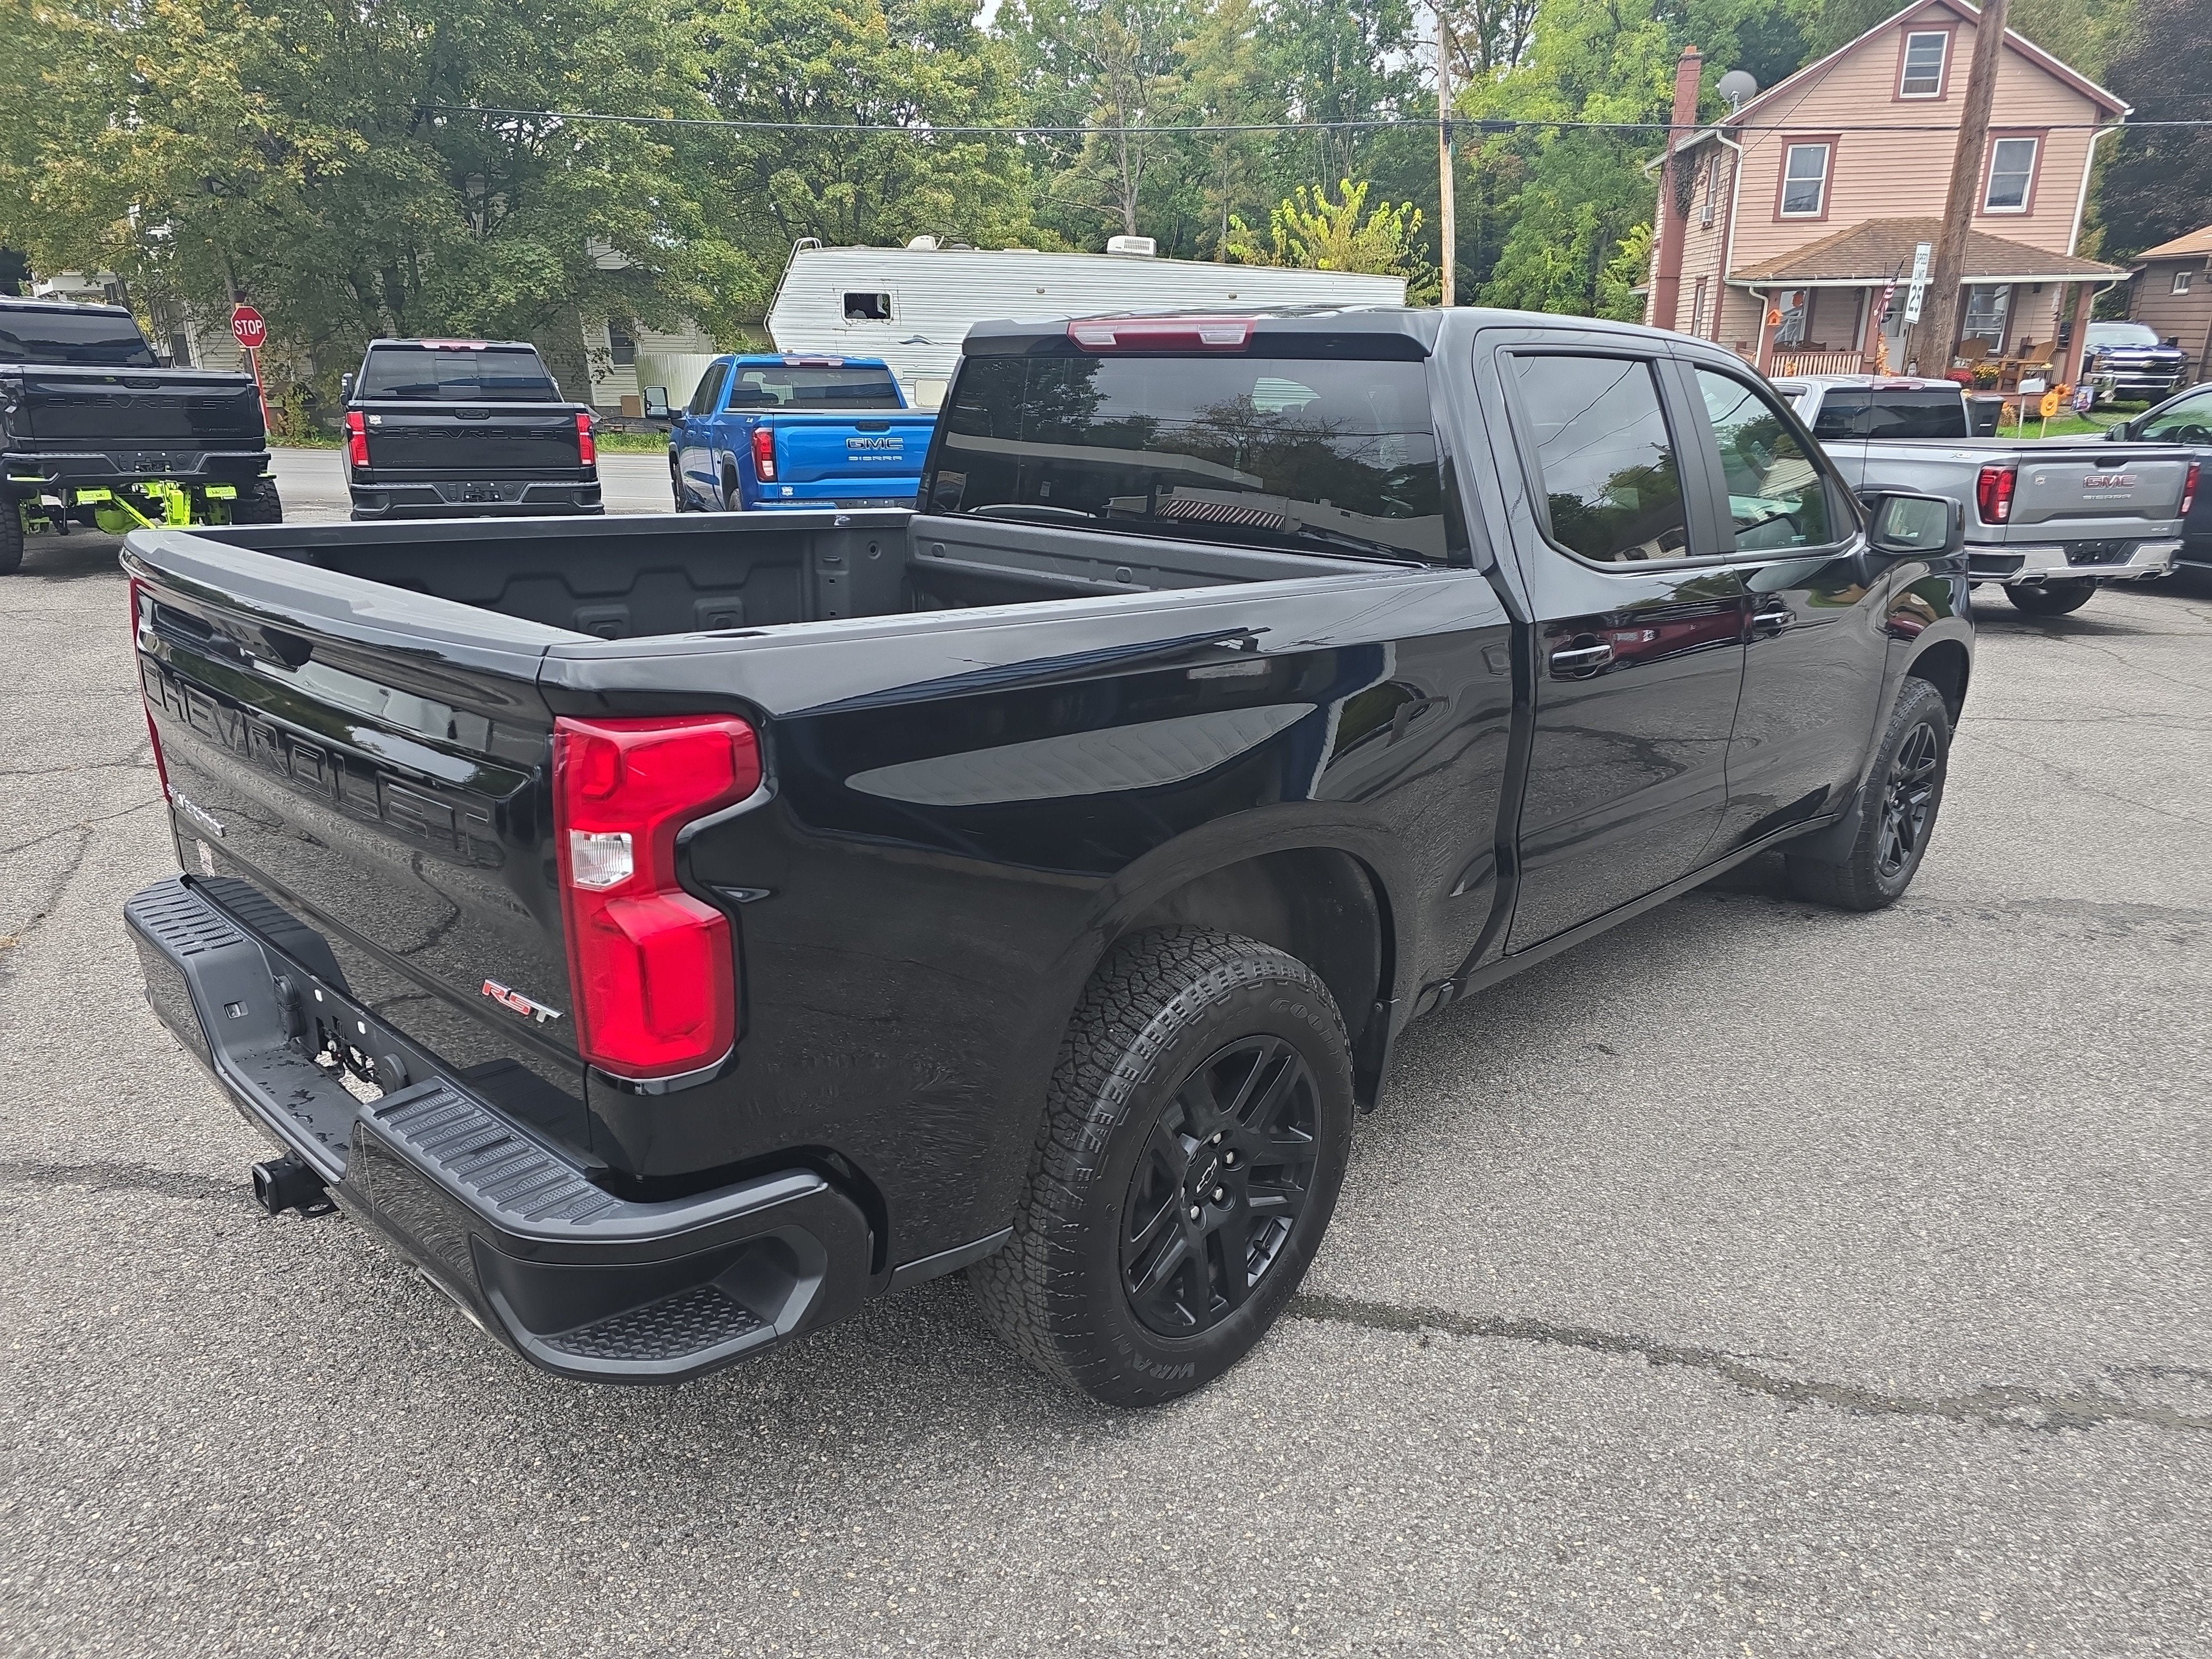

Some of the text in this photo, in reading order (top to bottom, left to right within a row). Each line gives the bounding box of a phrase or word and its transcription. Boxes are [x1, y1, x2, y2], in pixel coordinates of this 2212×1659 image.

[1915, 253, 1928, 265] SPEED
[1908, 285, 1922, 313] 25
[234, 319, 263, 335] STOP
[46, 397, 236, 410] CHEVROLET
[382, 429, 564, 440] CHEVROLET
[846, 438, 905, 450] GMC
[2083, 474, 2137, 489] GMC
[140, 656, 490, 857] CHEVROLET
[482, 979, 565, 1023] RST
